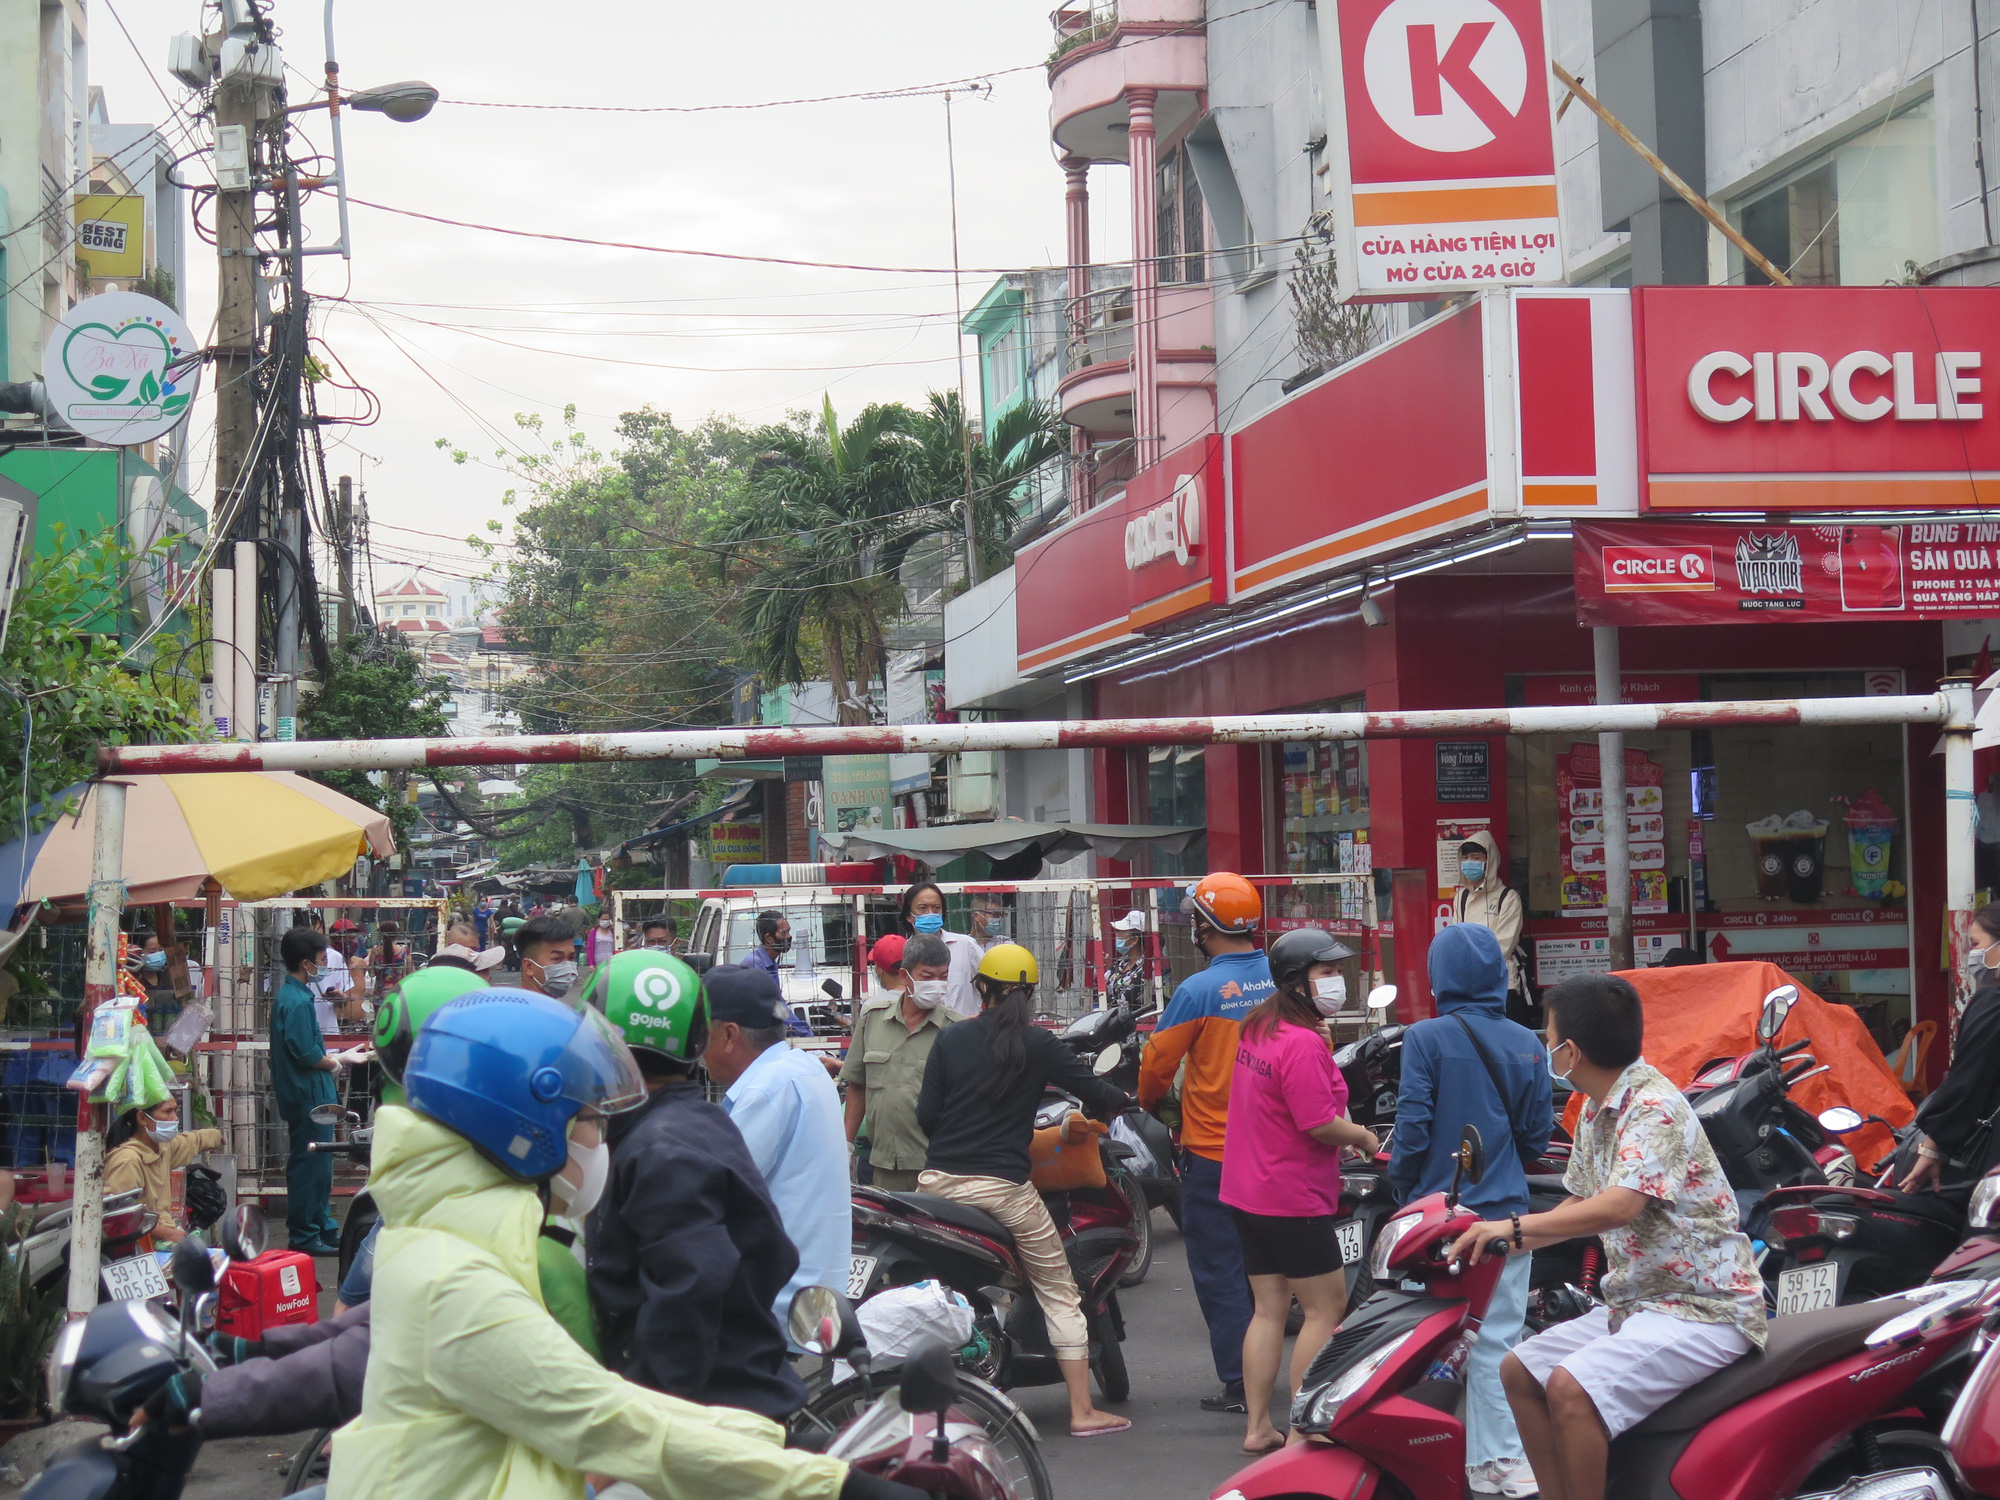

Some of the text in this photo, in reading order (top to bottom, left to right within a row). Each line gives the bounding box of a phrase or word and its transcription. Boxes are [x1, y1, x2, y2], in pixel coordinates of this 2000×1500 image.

[1405, 20, 1517, 140] K
[83, 223, 126, 239] BEST
[82, 234, 124, 249] BONG
[1362, 231, 1556, 256] CỬA HÀNG TIỆN LỢI
[1386, 256, 1536, 282] MỞ CỬA 24 GIỜ
[83, 345, 115, 372] Bà
[1687, 349, 1985, 423] CIRCLE
[74, 407, 154, 417] Vegan Restaurant
[1125, 502, 1175, 570] CIRCLE
[1612, 555, 1704, 578] CIRCLE K
[1910, 546, 1949, 571] SĂN
[1953, 546, 1992, 571] QUÀ
[1735, 560, 1803, 594] WARRIOR
[1912, 580, 1956, 590] IPHONE
[1959, 580, 1973, 589] 12
[1975, 577, 1992, 588] VÀ
[1913, 591, 1938, 602] QUÀ
[1560, 684, 1582, 693] Kính
[1630, 683, 1660, 692] Khách
[852, 770, 888, 780] TRANG
[830, 789, 867, 805] OANH
[869, 788, 887, 803] VY
[727, 844, 741, 853] CUA
[1723, 916, 1754, 924] CIRCLE
[1772, 914, 1798, 923] 24hrs
[1830, 912, 1861, 921] CIRCLE
[1879, 911, 1904, 920] 24hrs
[629, 1012, 672, 1030] gojek
[110, 1259, 152, 1284] 59-T2
[1788, 1267, 1828, 1293] 59-T2
[276, 1294, 310, 1313] NowFood
[1781, 1288, 1832, 1315] 007.72
[1408, 1432, 1453, 1446] HONDA
